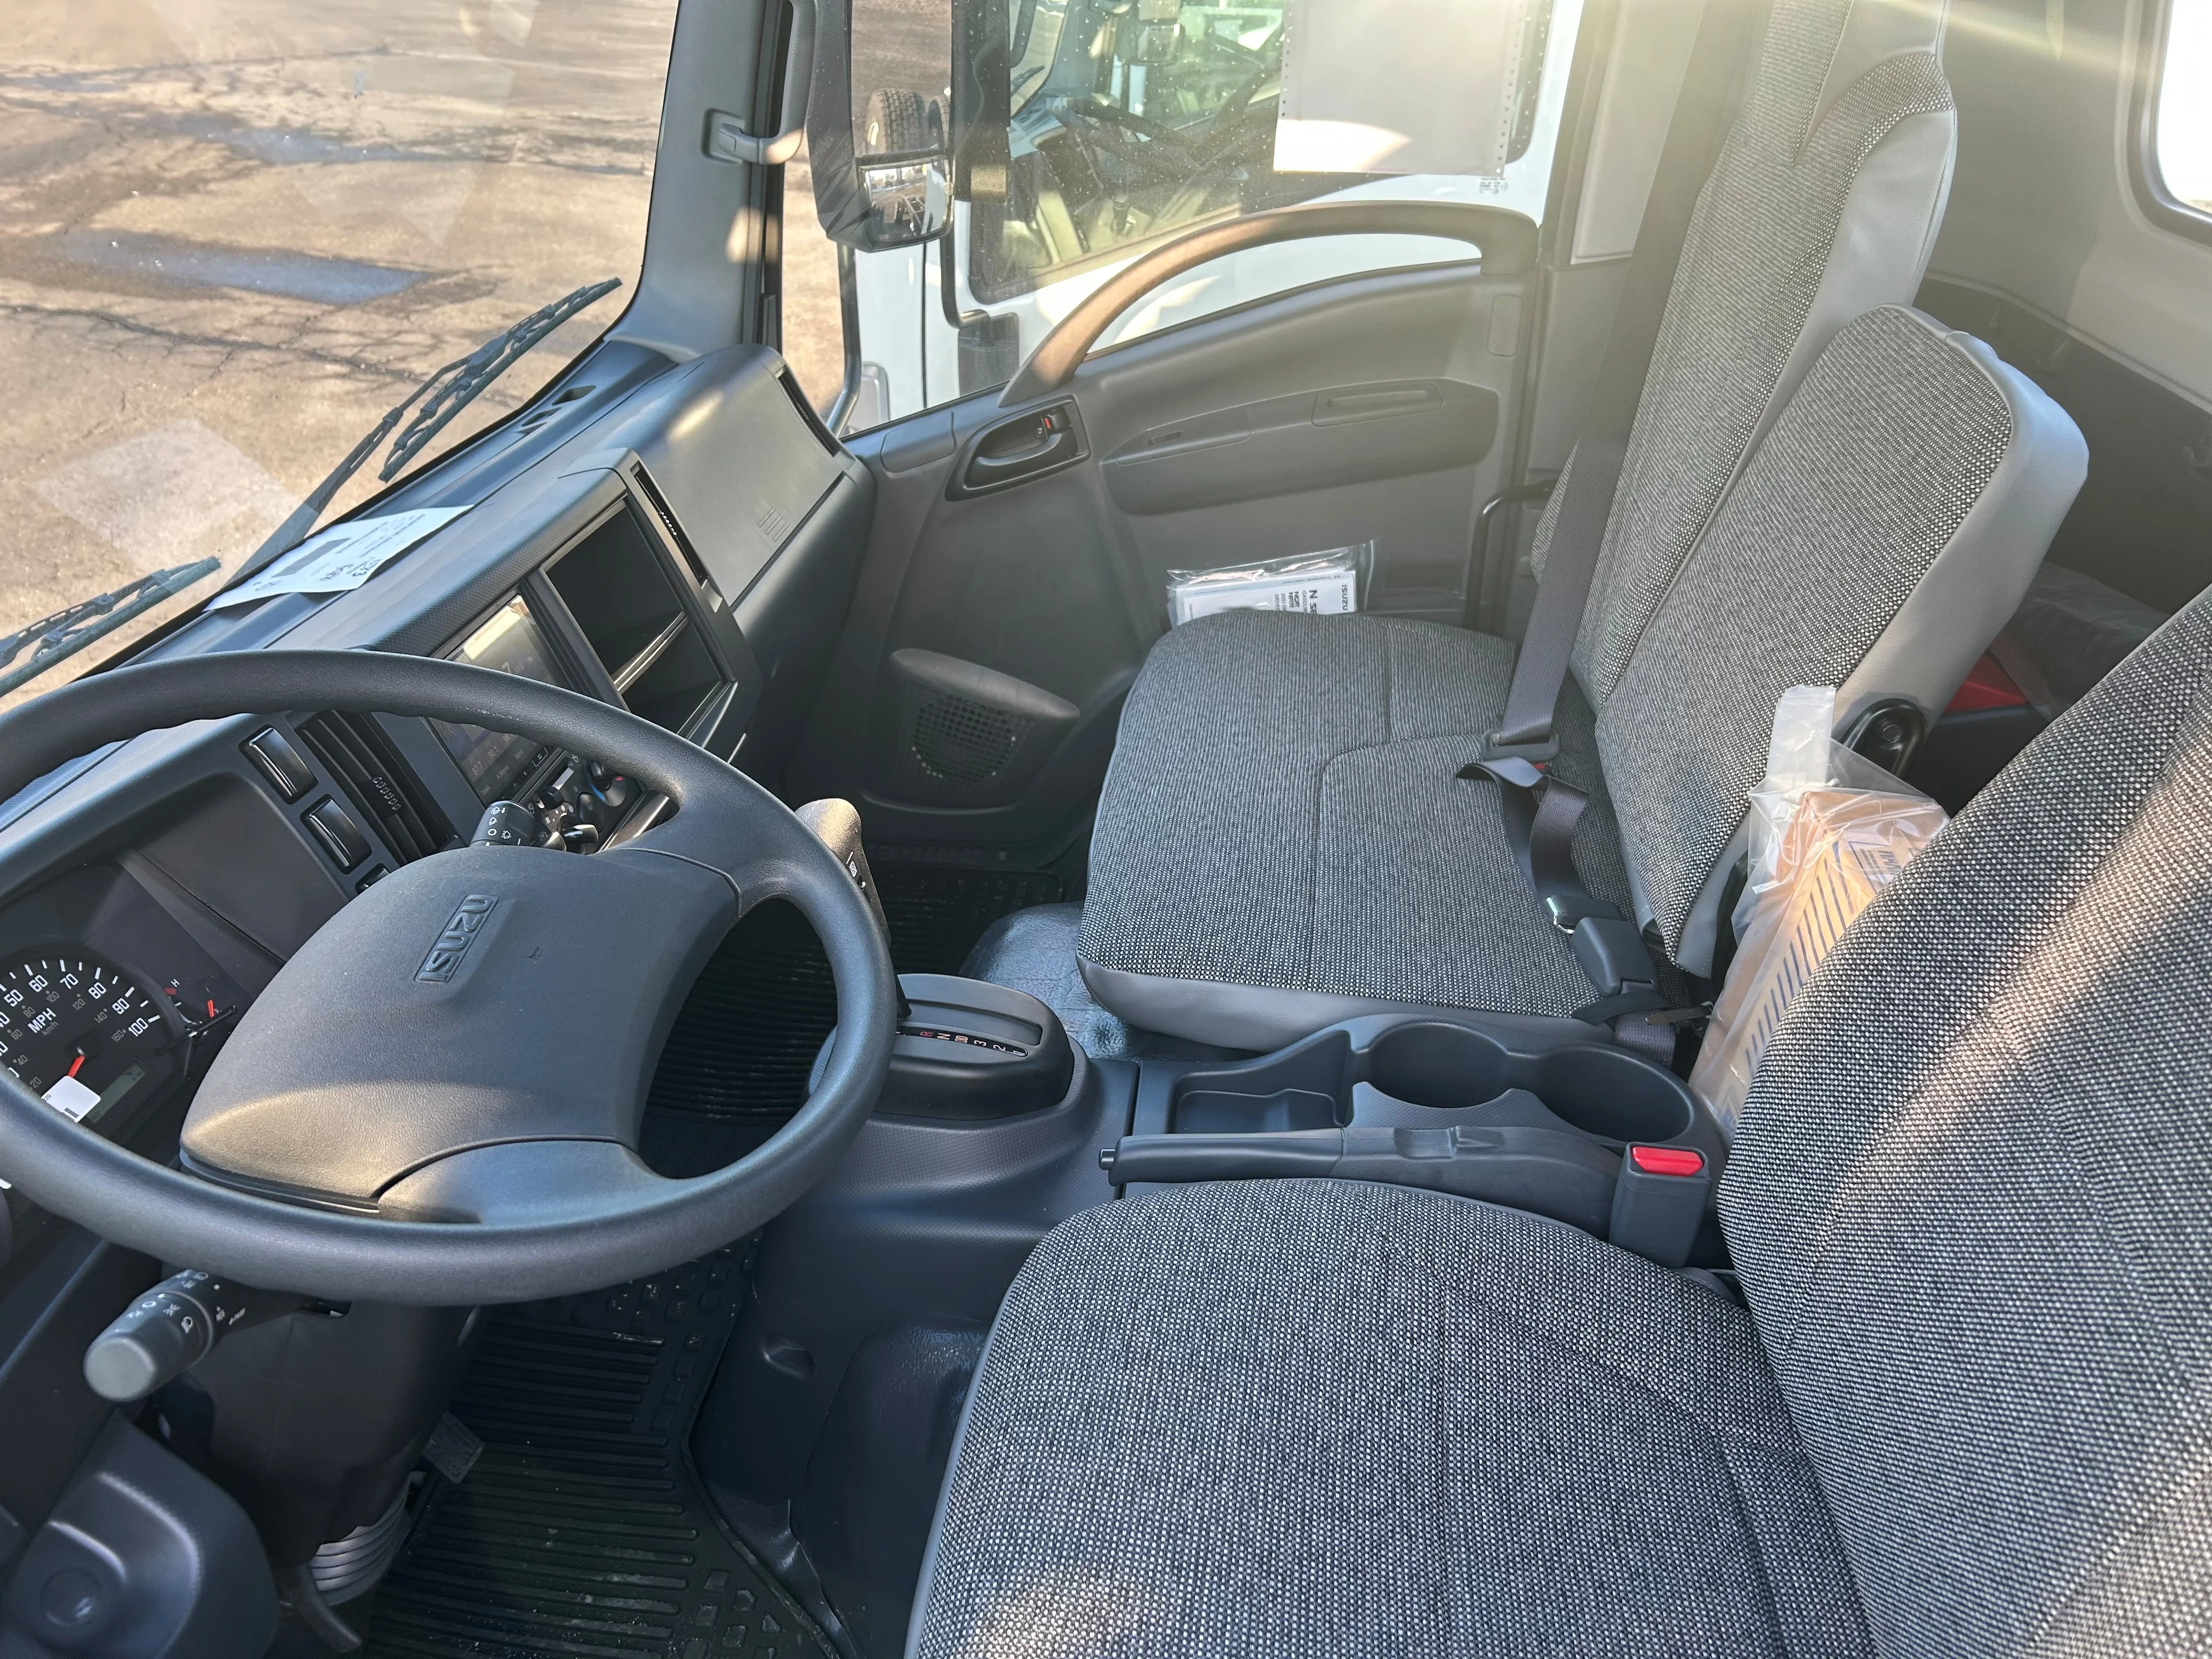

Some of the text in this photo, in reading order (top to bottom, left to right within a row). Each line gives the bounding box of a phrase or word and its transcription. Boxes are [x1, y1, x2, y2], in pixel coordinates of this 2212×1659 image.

[1309, 589, 1317, 599] N
[419, 894, 495, 981] ISUZU
[29, 974, 48, 992] 60
[60, 973, 78, 989] 70
[171, 979, 180, 987] H
[88, 981, 107, 999] 80
[3, 989, 24, 1007] 50
[72, 998, 86, 1011] 120
[24, 1006, 35, 1017] 80
[112, 997, 129, 1014] 90
[27, 1007, 57, 1033] MPH
[94, 1012, 107, 1024] 140
[42, 1021, 59, 1036] km/h
[128, 1017, 148, 1037] 100
[10, 1029, 22, 1040] 60
[111, 1030, 124, 1042] 160
[16, 1054, 28, 1066] 40
[30, 1076, 42, 1088] 20
